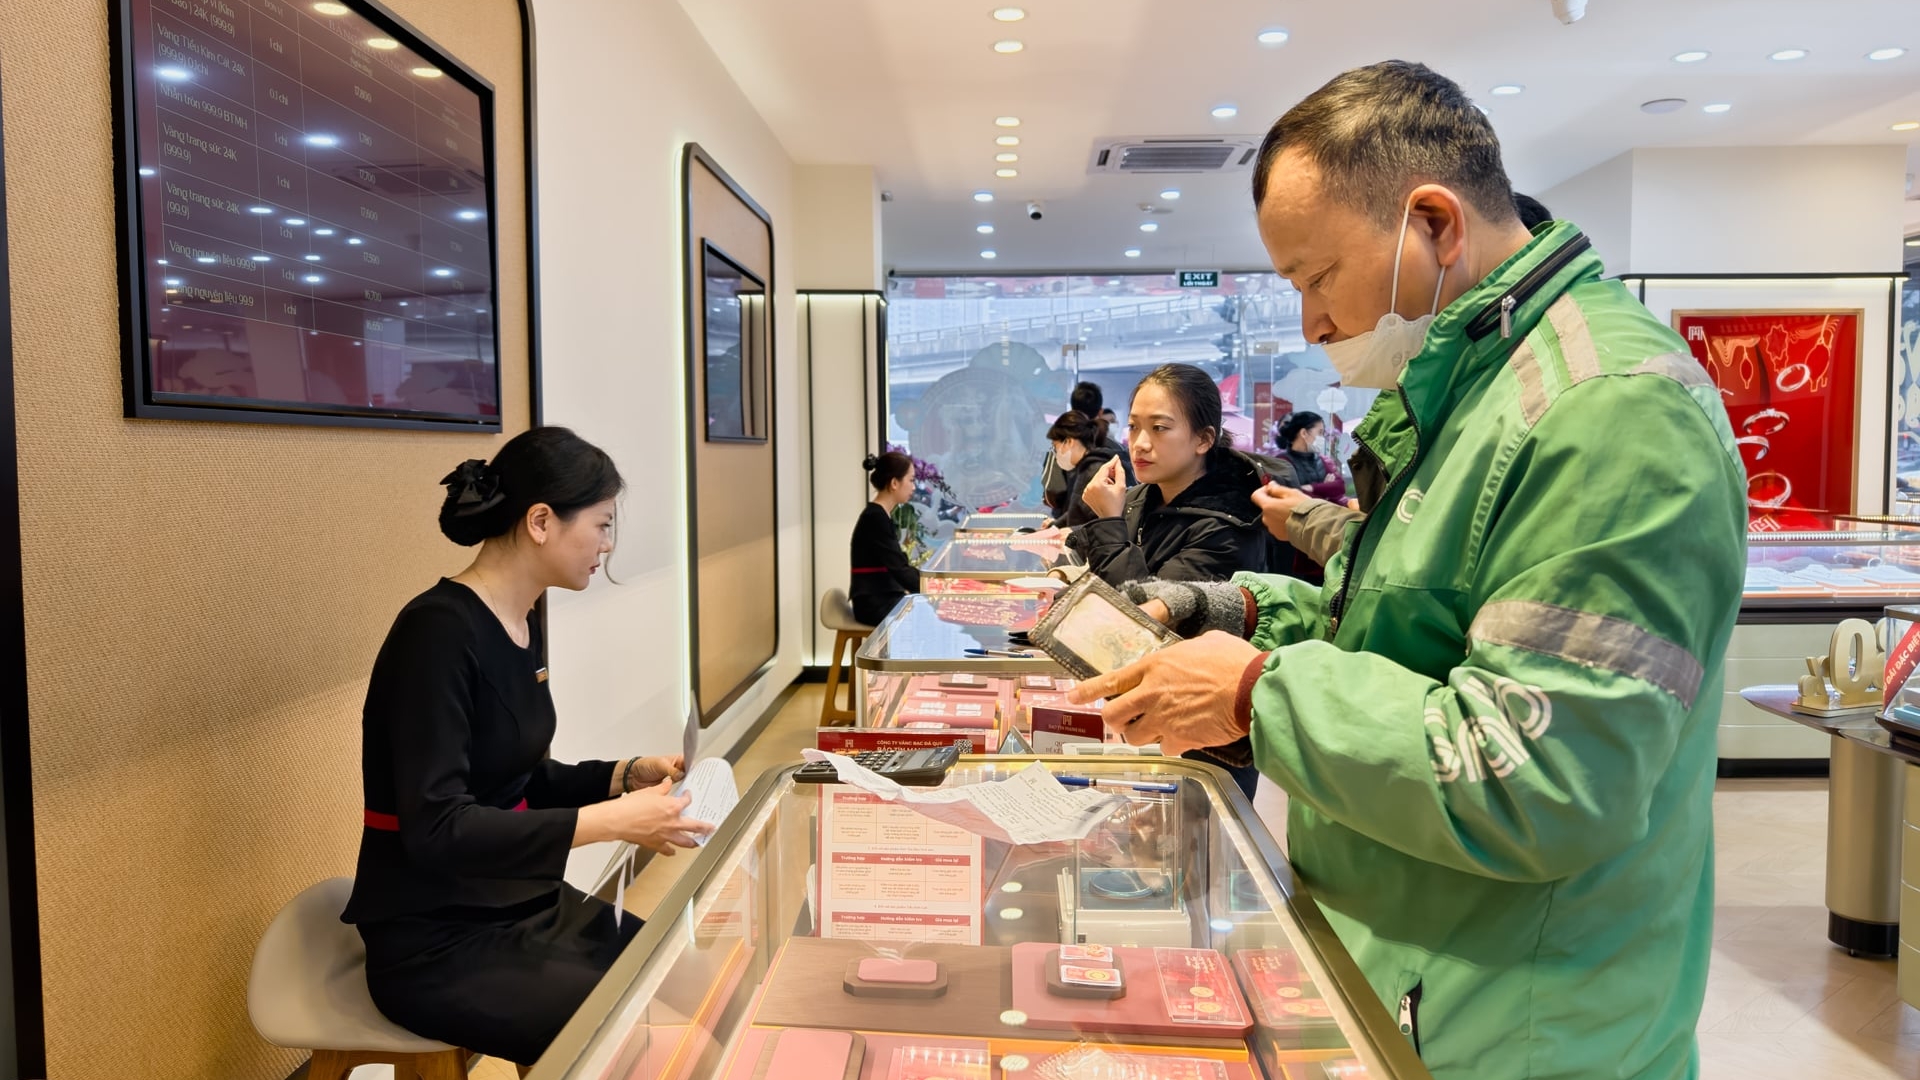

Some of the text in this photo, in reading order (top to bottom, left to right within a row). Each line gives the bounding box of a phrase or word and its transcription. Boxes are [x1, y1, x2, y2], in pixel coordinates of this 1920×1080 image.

[193, 4, 209, 22] 24K
[157, 23, 180, 46] Vàng
[200, 46, 216, 61] Kim
[231, 60, 246, 77] 24K
[223, 110, 248, 131] BTMH
[162, 121, 186, 145] Vàng
[186, 131, 208, 154] trang
[223, 145, 238, 162] 24K
[163, 141, 192, 165] (999.9)
[166, 180, 189, 203] Vàng
[189, 189, 211, 210] trang
[225, 200, 240, 215] 24K
[167, 200, 190, 221] (99.9)
[169, 239, 191, 260] Vàng
[236, 257, 257, 272] 999.9
[238, 294, 254, 307] 99.9
